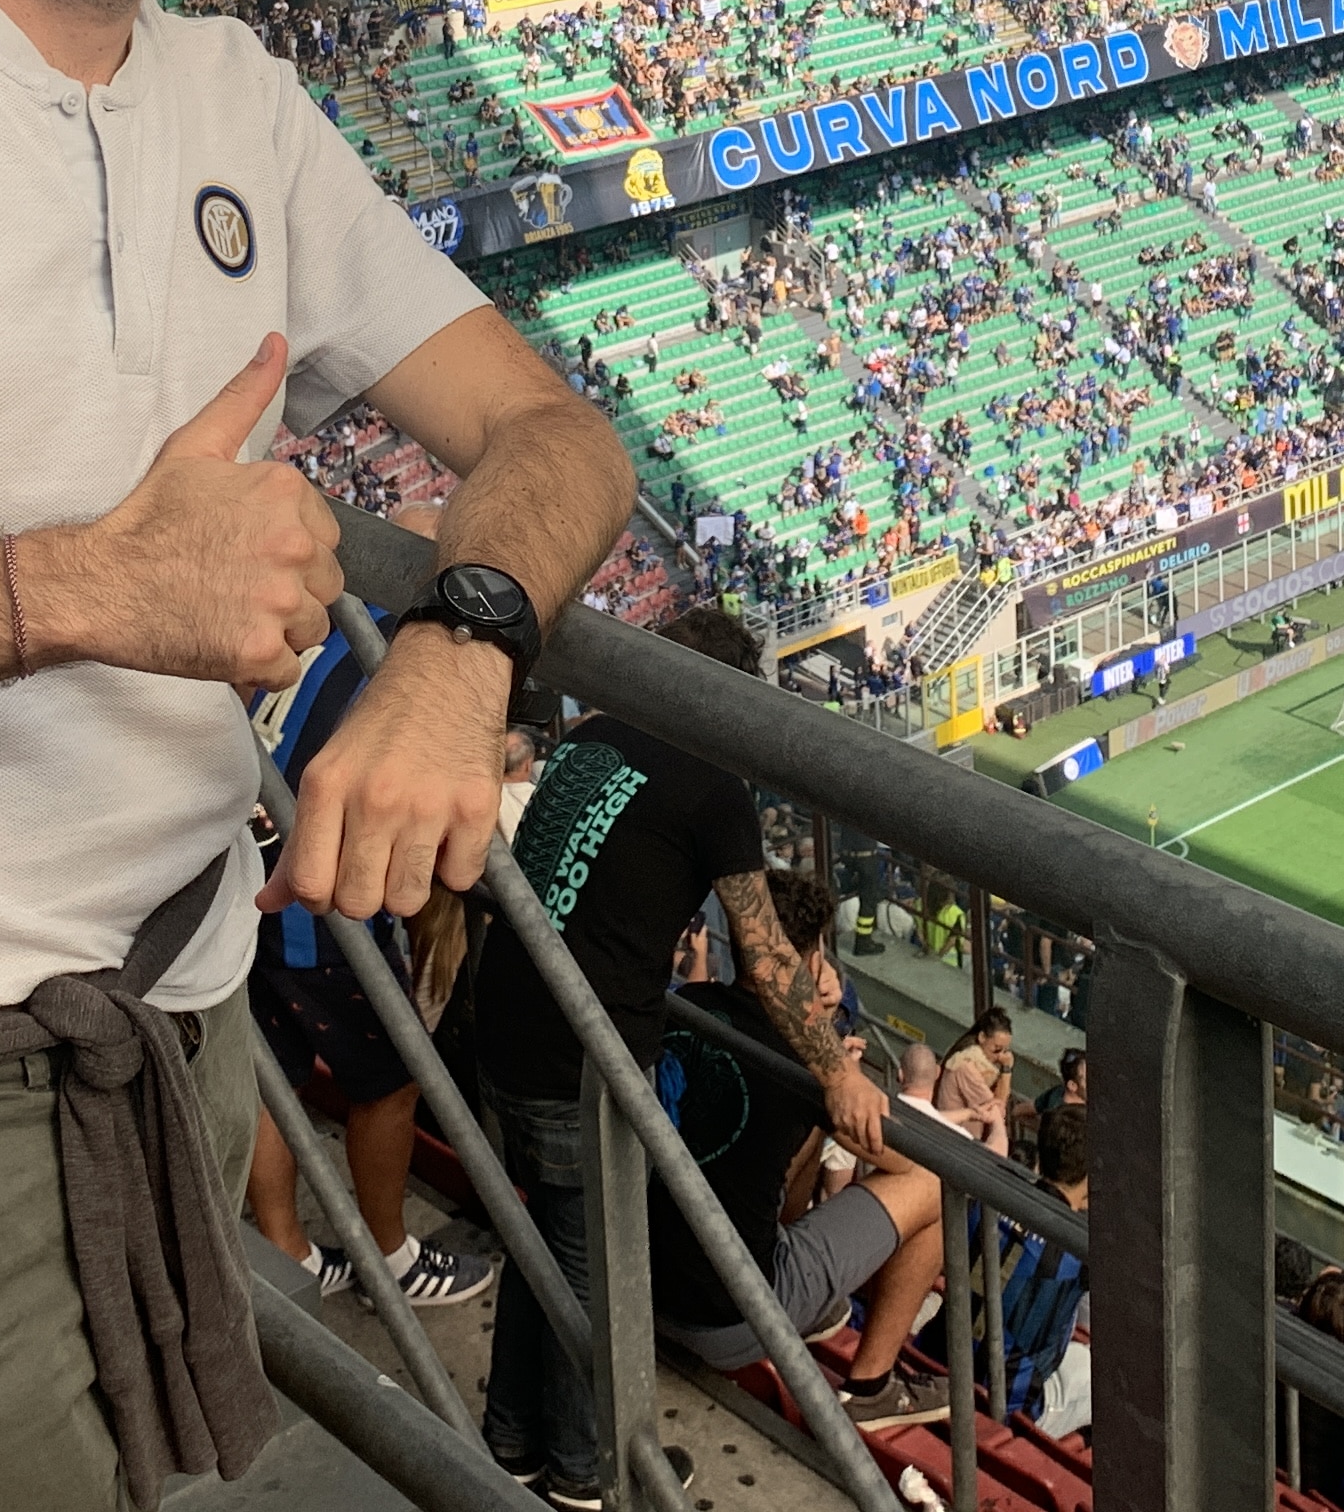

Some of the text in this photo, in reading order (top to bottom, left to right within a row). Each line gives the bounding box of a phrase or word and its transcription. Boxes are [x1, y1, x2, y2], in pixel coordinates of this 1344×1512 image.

[708, 29, 1151, 189] CURVA NORD
[629, 194, 677, 218] 1975
[418, 219, 461, 246] 977
[1062, 536, 1177, 590] ROCCASPINALVETI
[1159, 542, 1211, 573] DELIRIO
[1065, 573, 1130, 608] ROZZANO
[1103, 661, 1135, 691] INTER
[555, 798, 605, 878] WALL
[599, 765, 633, 797] IS
[547, 860, 591, 933] TOO
[579, 769, 650, 860] HIGH
